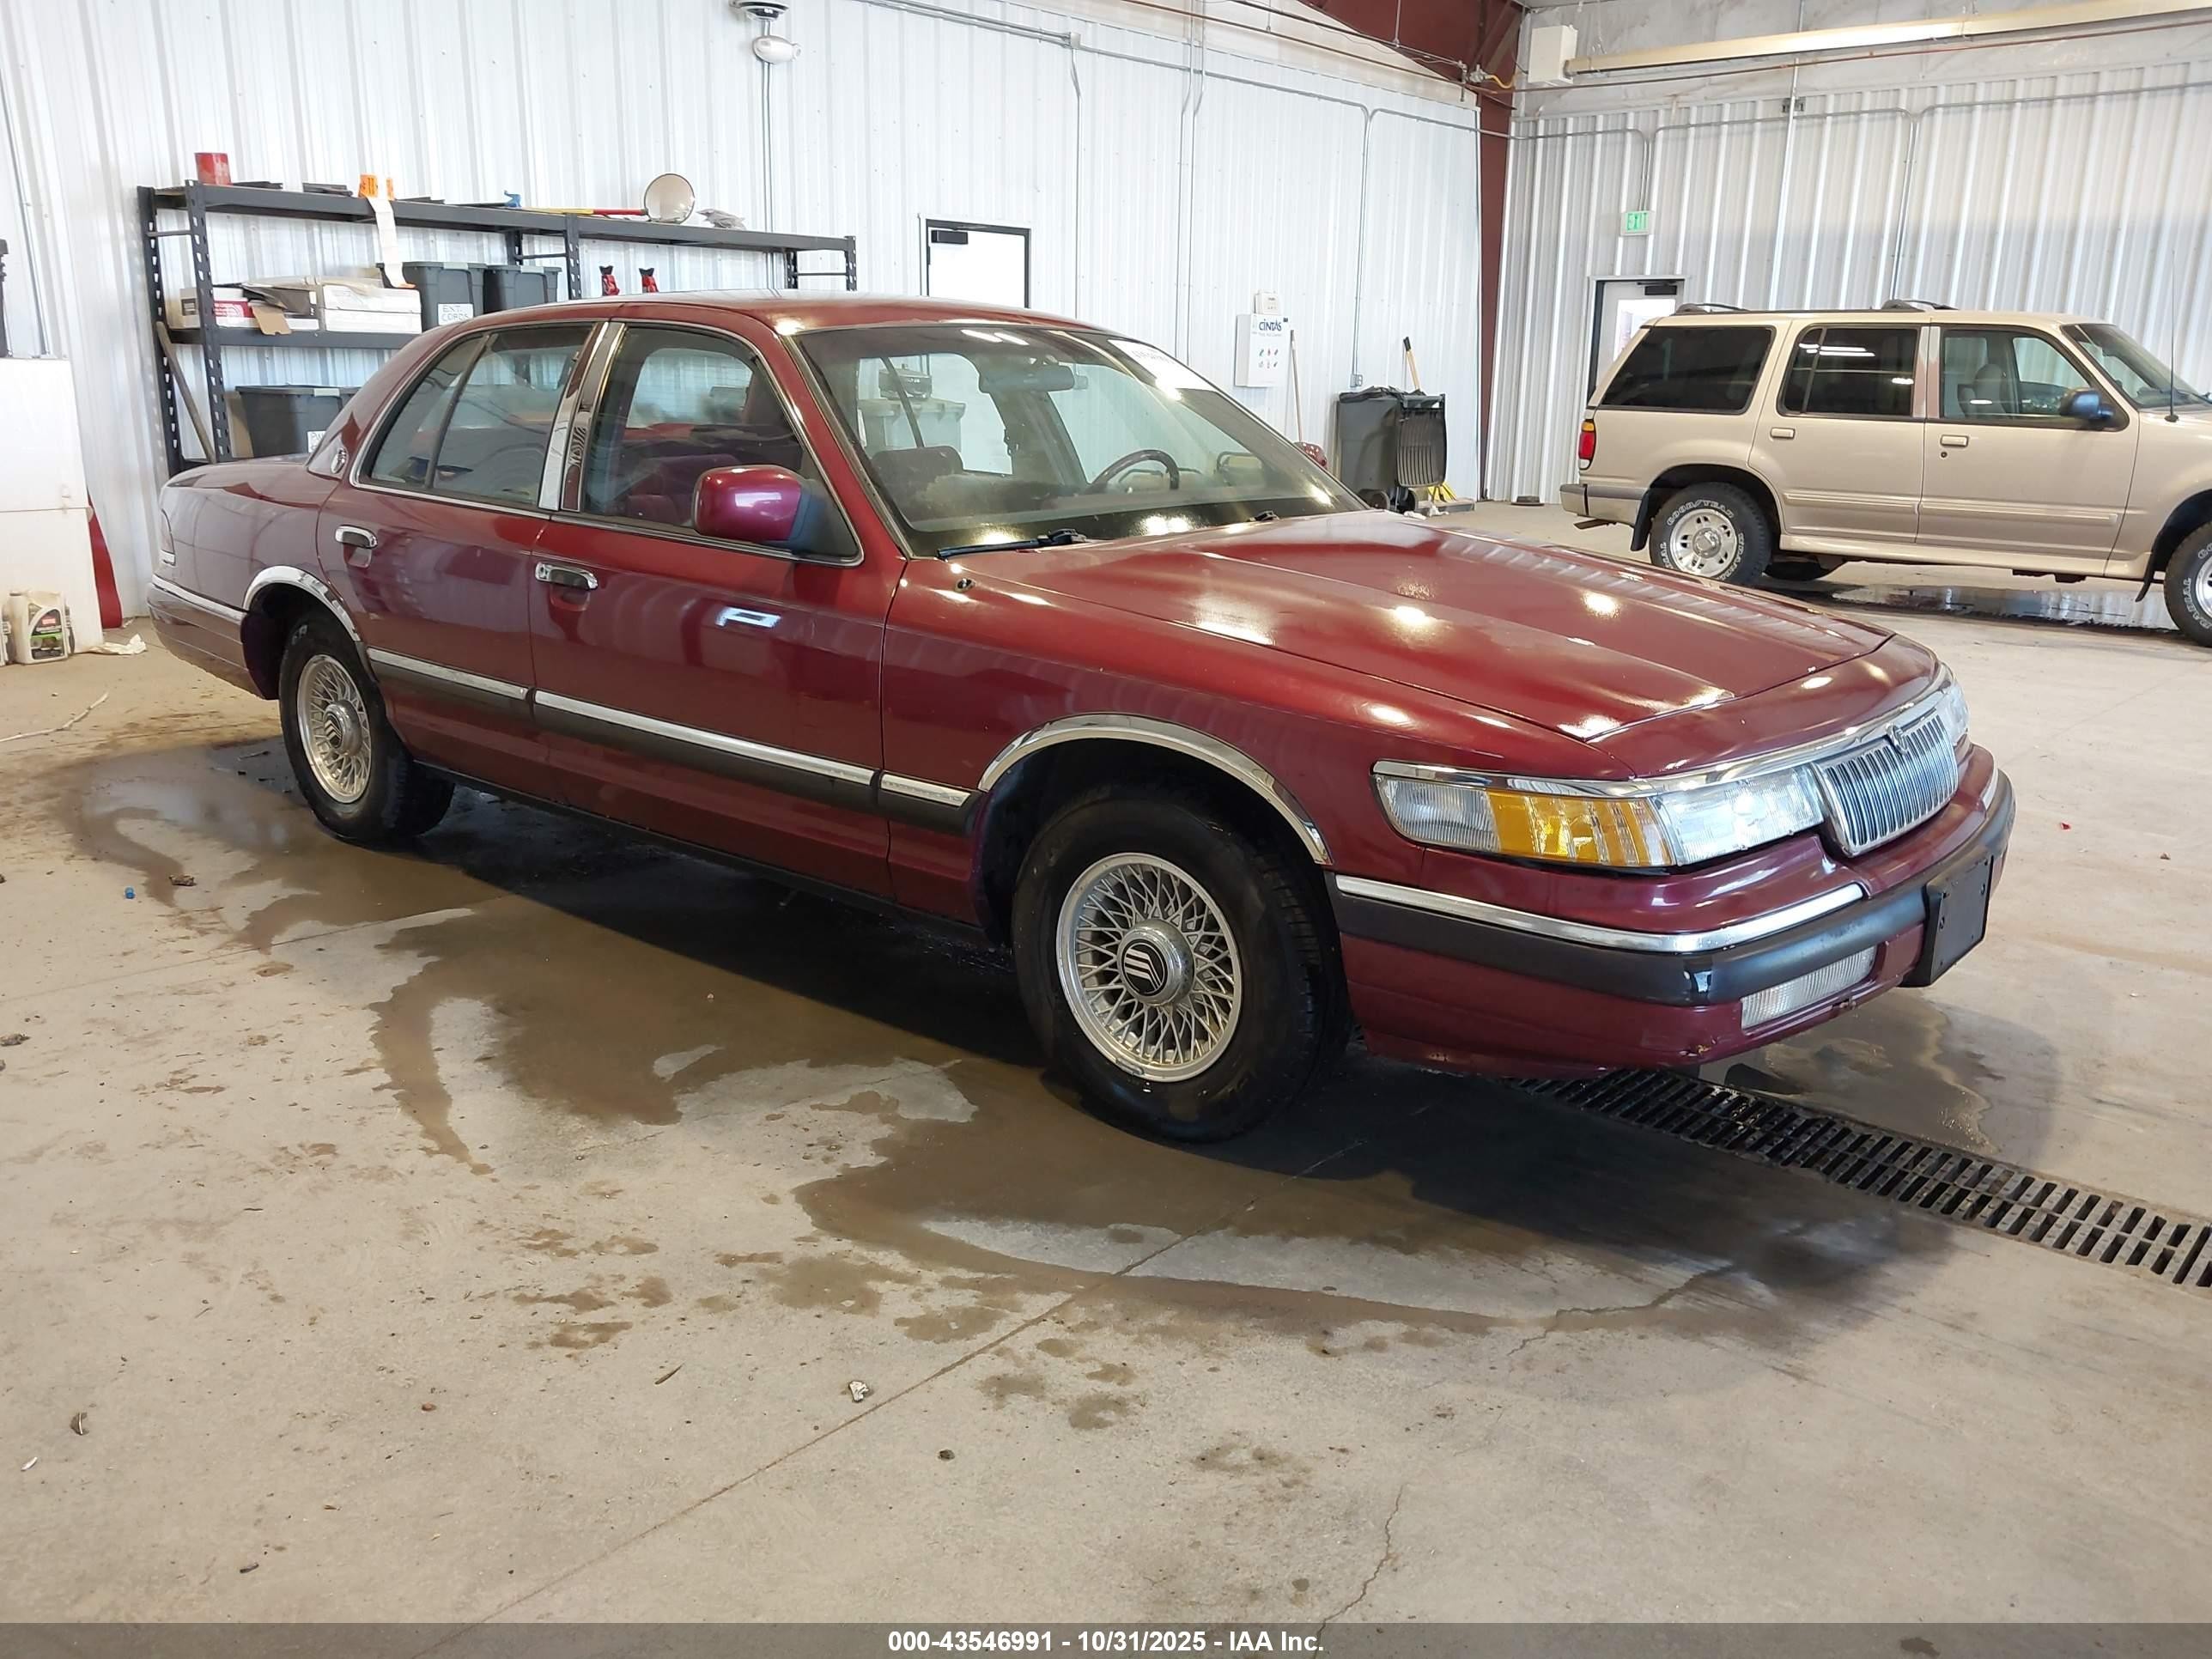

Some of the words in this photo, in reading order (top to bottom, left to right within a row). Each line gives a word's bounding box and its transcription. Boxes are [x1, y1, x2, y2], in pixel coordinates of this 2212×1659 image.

[1627, 212, 1649, 230] EXIT
[1258, 319, 1282, 331] CINTAS
[1666, 499, 1735, 526] GOODYEAR
